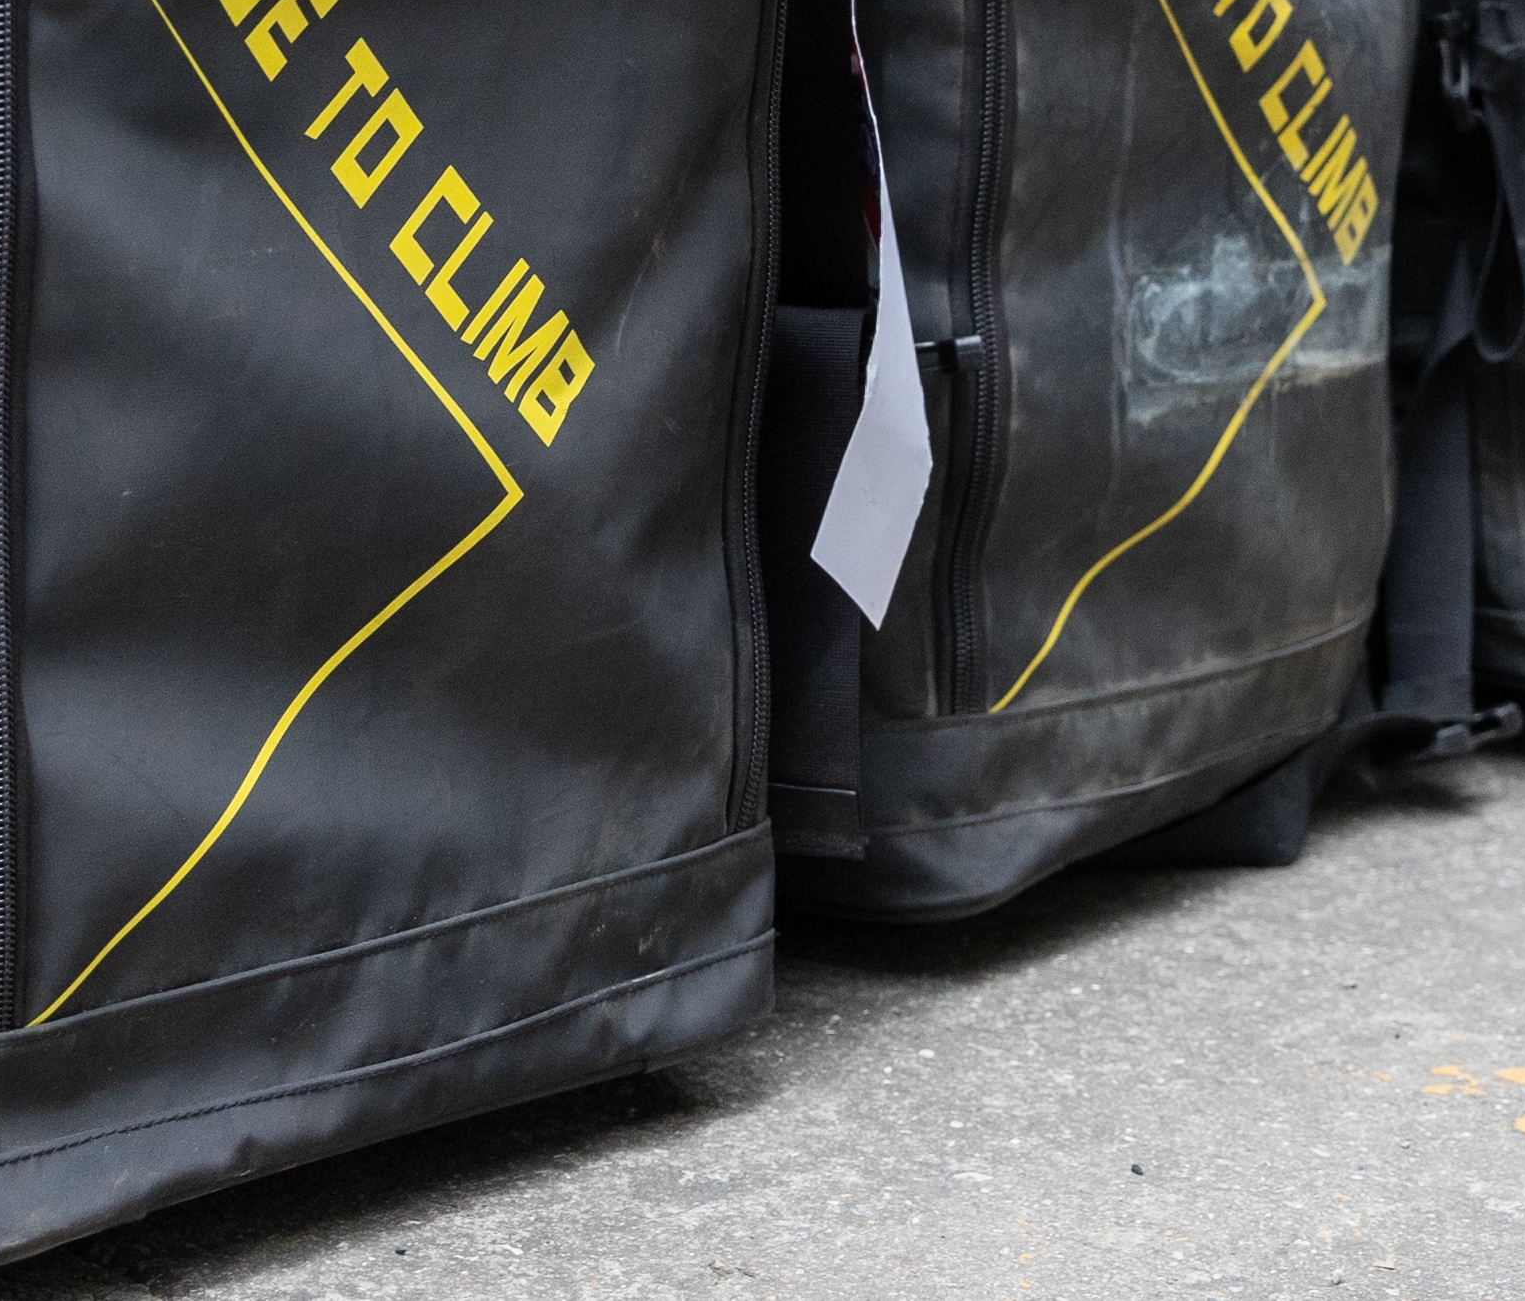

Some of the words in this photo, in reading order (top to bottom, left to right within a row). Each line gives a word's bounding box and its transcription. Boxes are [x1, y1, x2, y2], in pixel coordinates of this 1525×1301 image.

[304, 37, 424, 209] TO
[390, 165, 596, 447] CLIMB
[1259, 39, 1379, 266] CLIMB
